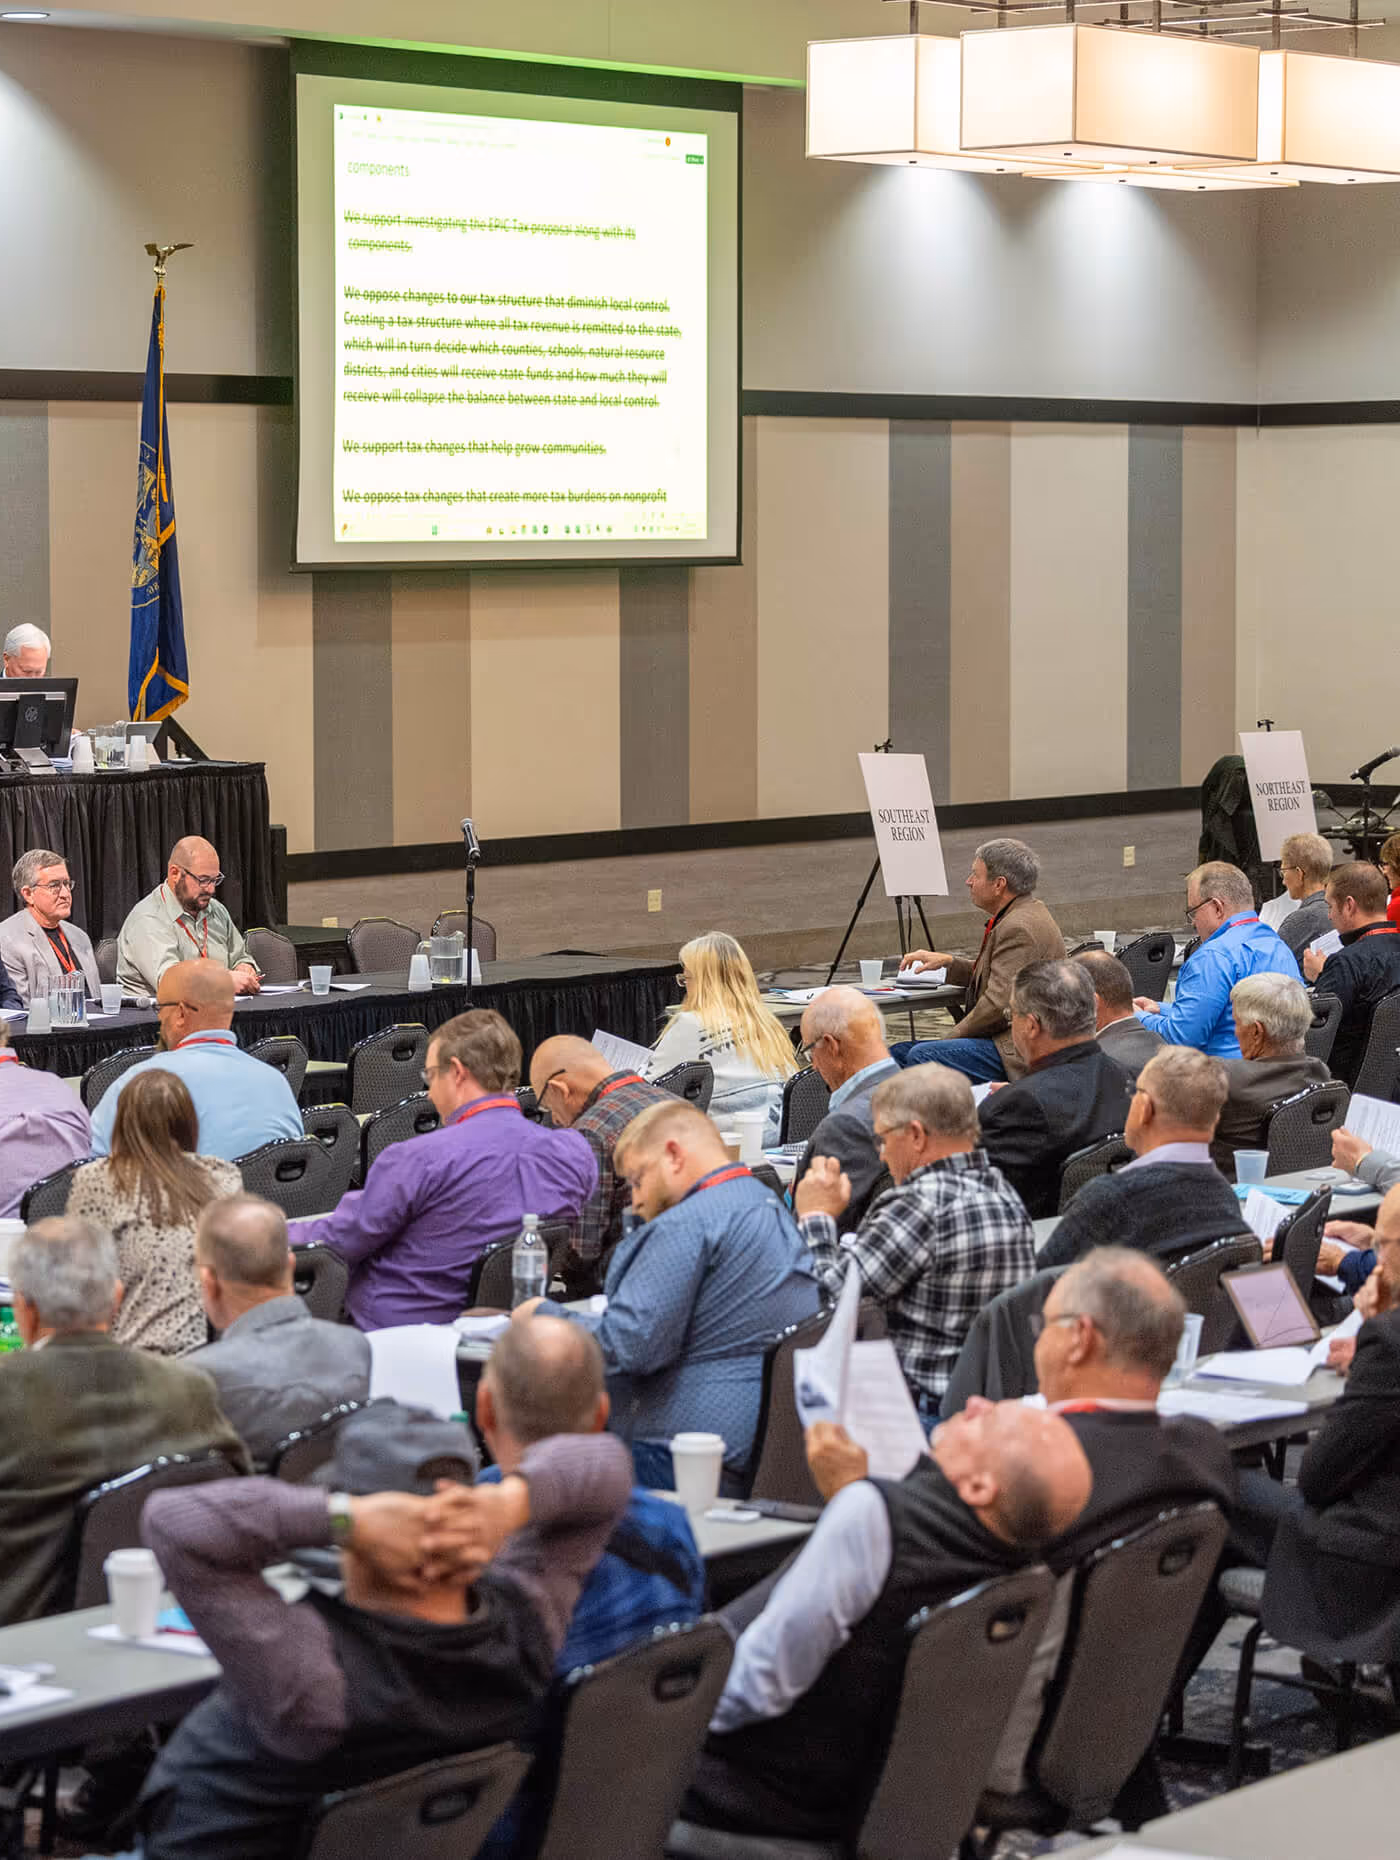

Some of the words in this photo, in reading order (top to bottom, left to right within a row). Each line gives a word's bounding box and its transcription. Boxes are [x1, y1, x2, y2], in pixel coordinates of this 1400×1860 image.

[347, 161, 411, 177] components
[344, 209, 360, 223] We
[363, 213, 401, 231] support
[405, 215, 467, 233] investigating
[470, 217, 486, 231] the
[531, 222, 572, 238] proposal
[574, 223, 600, 240] along
[602, 224, 623, 239] with
[344, 286, 360, 300] We
[363, 289, 400, 304] oppose
[403, 288, 444, 306] changes
[447, 291, 458, 304] to
[460, 293, 478, 304] our
[480, 293, 496, 305] tax
[499, 293, 542, 307] structure
[545, 294, 565, 307] that
[567, 295, 608, 309] diminish
[610, 296, 632, 310] local
[634, 297, 670, 312] control.
[344, 311, 385, 330] Creating
[388, 316, 394, 327] a
[397, 314, 413, 327] tax
[416, 314, 462, 328] structure
[465, 315, 496, 329] where
[499, 316, 511, 330] all
[513, 319, 528, 331] tax
[530, 320, 569, 333] revenue
[572, 320, 580, 333] is
[582, 320, 624, 335] remitted
[626, 322, 636, 335] to
[638, 322, 654, 336] the
[344, 336, 372, 351] which
[375, 336, 394, 351] will
[397, 337, 406, 351] in
[409, 339, 432, 352] turn
[434, 339, 467, 353] decide
[470, 340, 500, 354] which
[502, 342, 546, 358] counties,
[548, 343, 586, 359] schools,
[589, 344, 623, 359] natural
[625, 347, 665, 360] resource
[344, 361, 387, 379] districts,
[389, 362, 409, 377] and
[411, 363, 438, 377] cities
[440, 363, 459, 378] will
[462, 365, 497, 379] receive
[500, 367, 524, 381] state
[526, 365, 554, 381] funds
[556, 367, 574, 381] and
[576, 367, 597, 382] how
[599, 368, 625, 383] much
[627, 369, 648, 387] they
[650, 370, 667, 384] will
[343, 388, 379, 402] receive
[382, 387, 401, 403] will
[403, 388, 446, 406] collapse
[448, 389, 465, 403] the
[467, 389, 505, 404] balance
[508, 390, 550, 405] between
[553, 392, 577, 406] state
[579, 392, 597, 406] and
[599, 392, 622, 406] local
[624, 393, 660, 407] control.
[343, 439, 360, 453] We
[362, 440, 404, 456] support
[406, 440, 423, 453] tax
[425, 439, 465, 457] changes
[468, 440, 489, 453] that
[491, 440, 513, 457] help
[515, 442, 540, 458] grow
[542, 440, 607, 455] communities.
[343, 488, 361, 503] We
[363, 491, 401, 508] oppose
[404, 490, 420, 503] tax
[423, 488, 464, 506] changes
[466, 488, 486, 502] that
[489, 490, 520, 503] create
[523, 491, 548, 503] more
[550, 491, 566, 502] tax
[568, 488, 607, 503] burdens
[609, 491, 621, 503] on
[623, 488, 667, 505] nonprofit
[1255, 780, 1307, 796] NORTHEAST
[1267, 796, 1301, 812] REGION
[878, 808, 931, 824] SOUTHEAST
[890, 826, 926, 841] REGION
